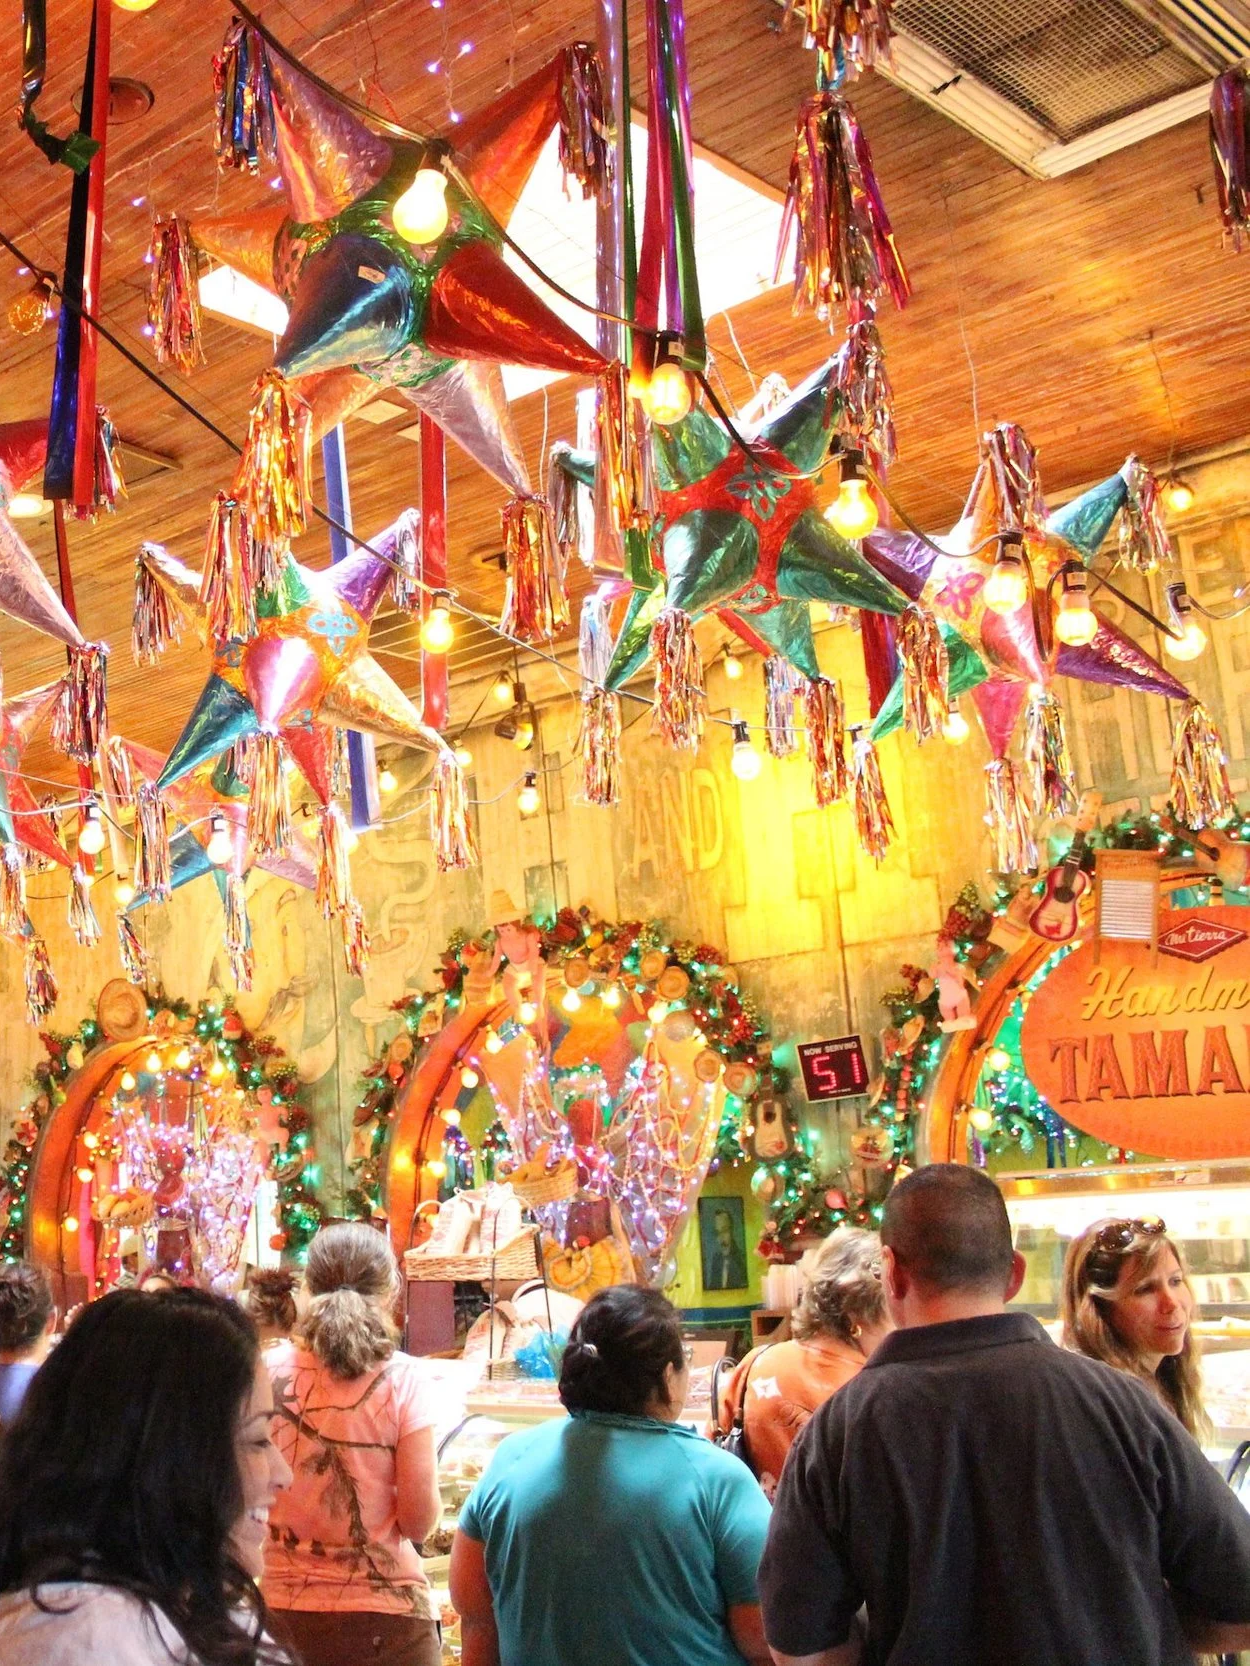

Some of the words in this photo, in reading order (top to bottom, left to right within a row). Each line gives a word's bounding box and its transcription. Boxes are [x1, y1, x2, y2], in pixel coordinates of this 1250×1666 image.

[633, 768, 724, 877] AND
[803, 1047, 822, 1057] NOW
[824, 1041, 858, 1053] SERVING
[812, 1052, 861, 1091] 51
[1050, 1024, 1250, 1104] TAMA
